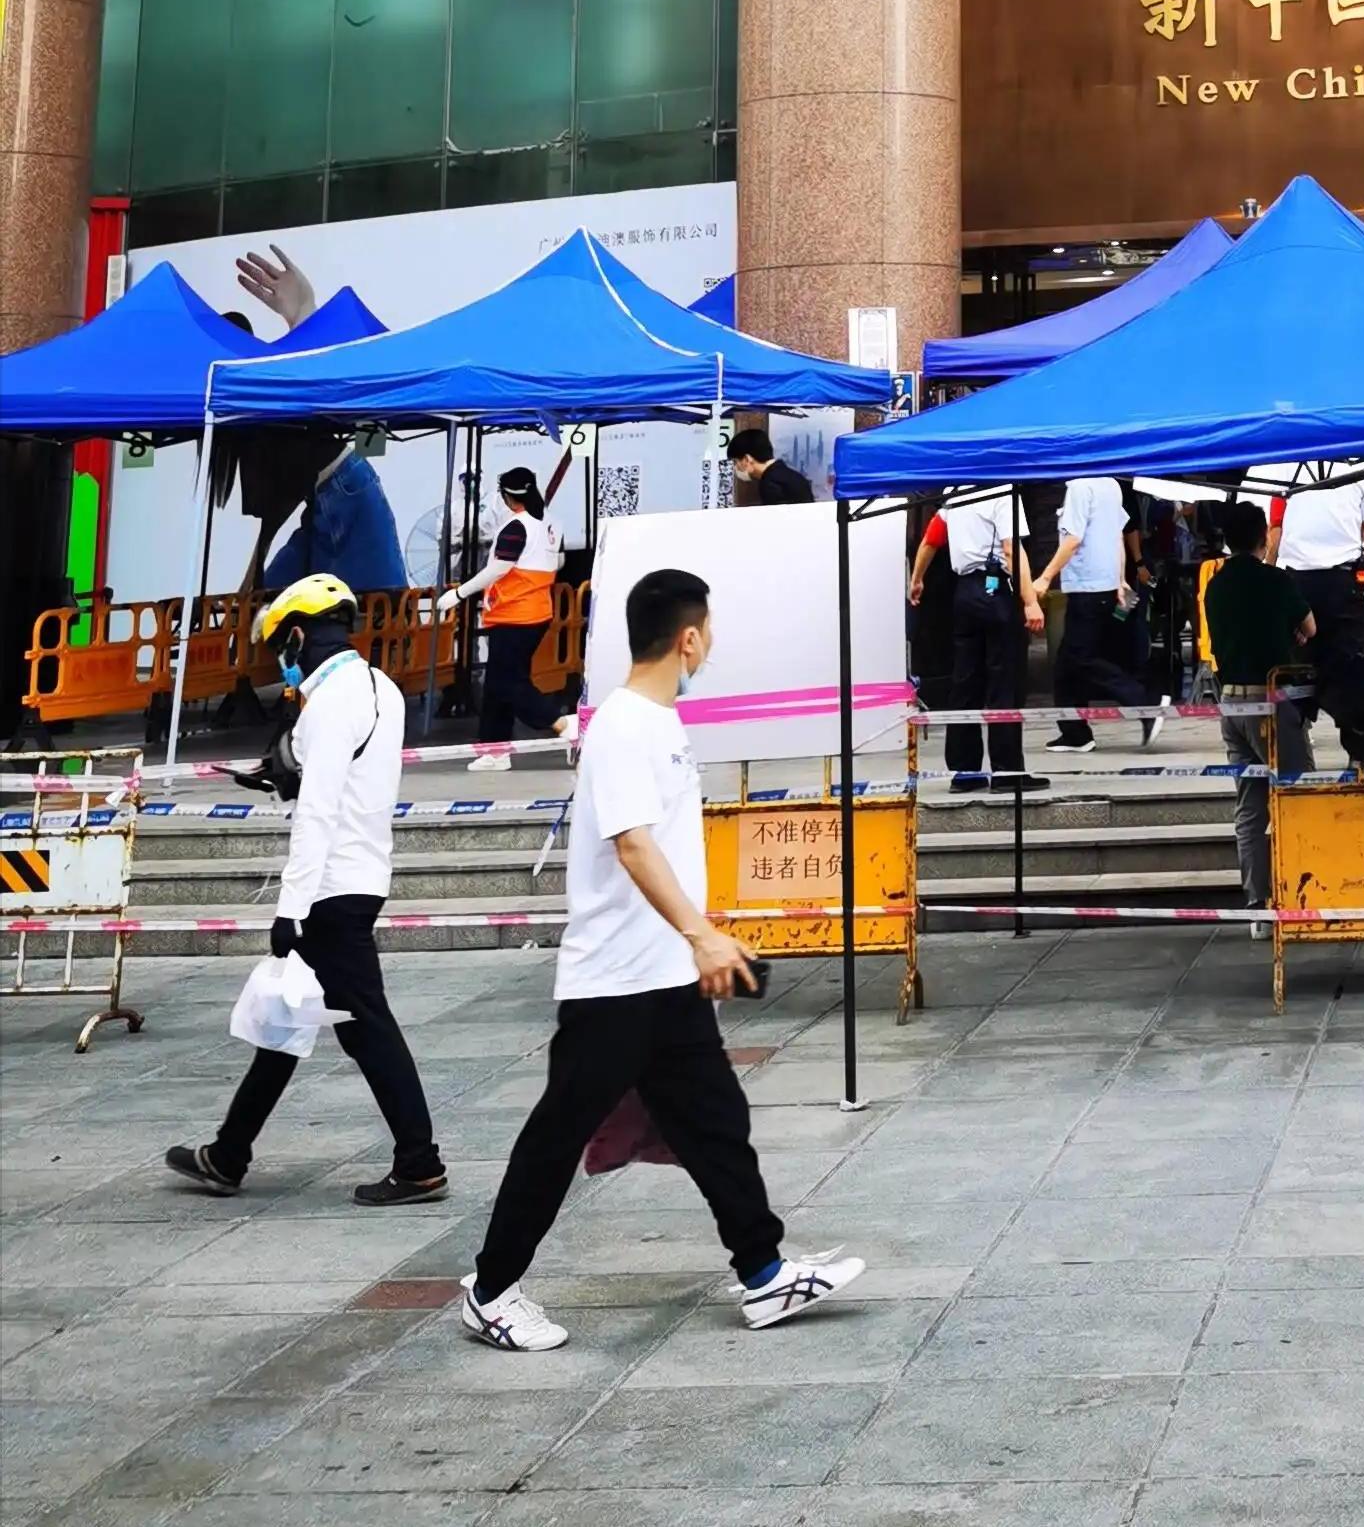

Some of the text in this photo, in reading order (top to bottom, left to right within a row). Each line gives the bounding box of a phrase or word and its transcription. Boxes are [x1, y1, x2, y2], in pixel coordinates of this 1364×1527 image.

[1155, 74, 1261, 107] New
[752, 817, 843, 845] 不准停车
[751, 853, 843, 880] 违者自负
